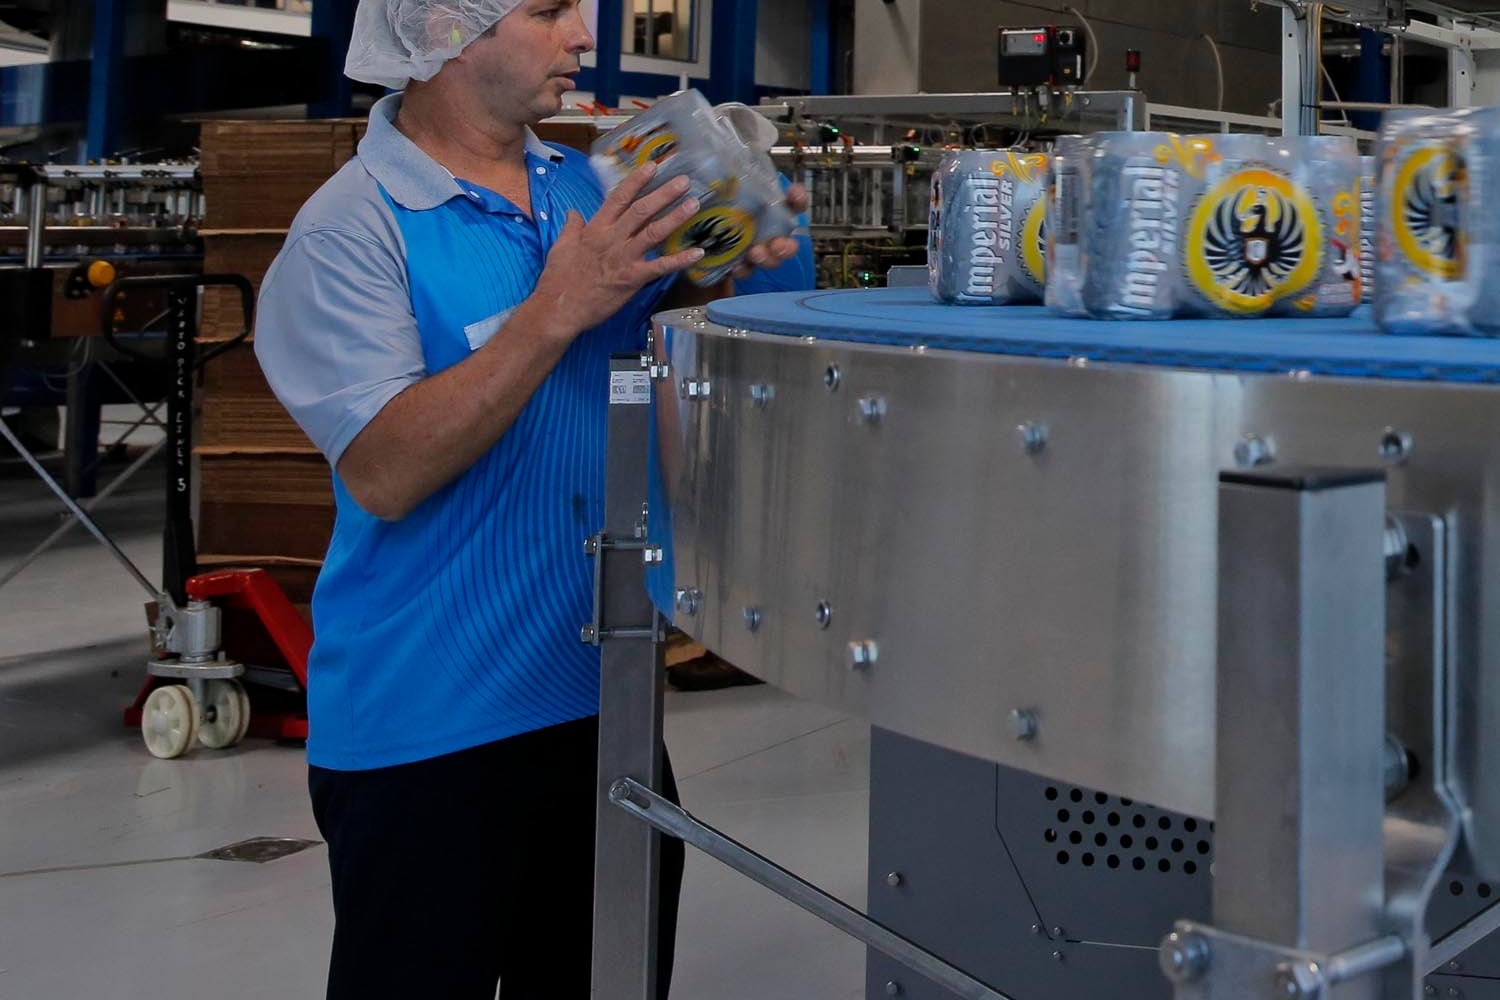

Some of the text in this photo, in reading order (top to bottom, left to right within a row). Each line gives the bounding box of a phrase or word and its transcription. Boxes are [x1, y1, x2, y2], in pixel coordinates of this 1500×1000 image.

[955, 171, 1004, 301] Imperial
[1000, 180, 1013, 251] SILVER
[1107, 158, 1168, 316] Imperial
